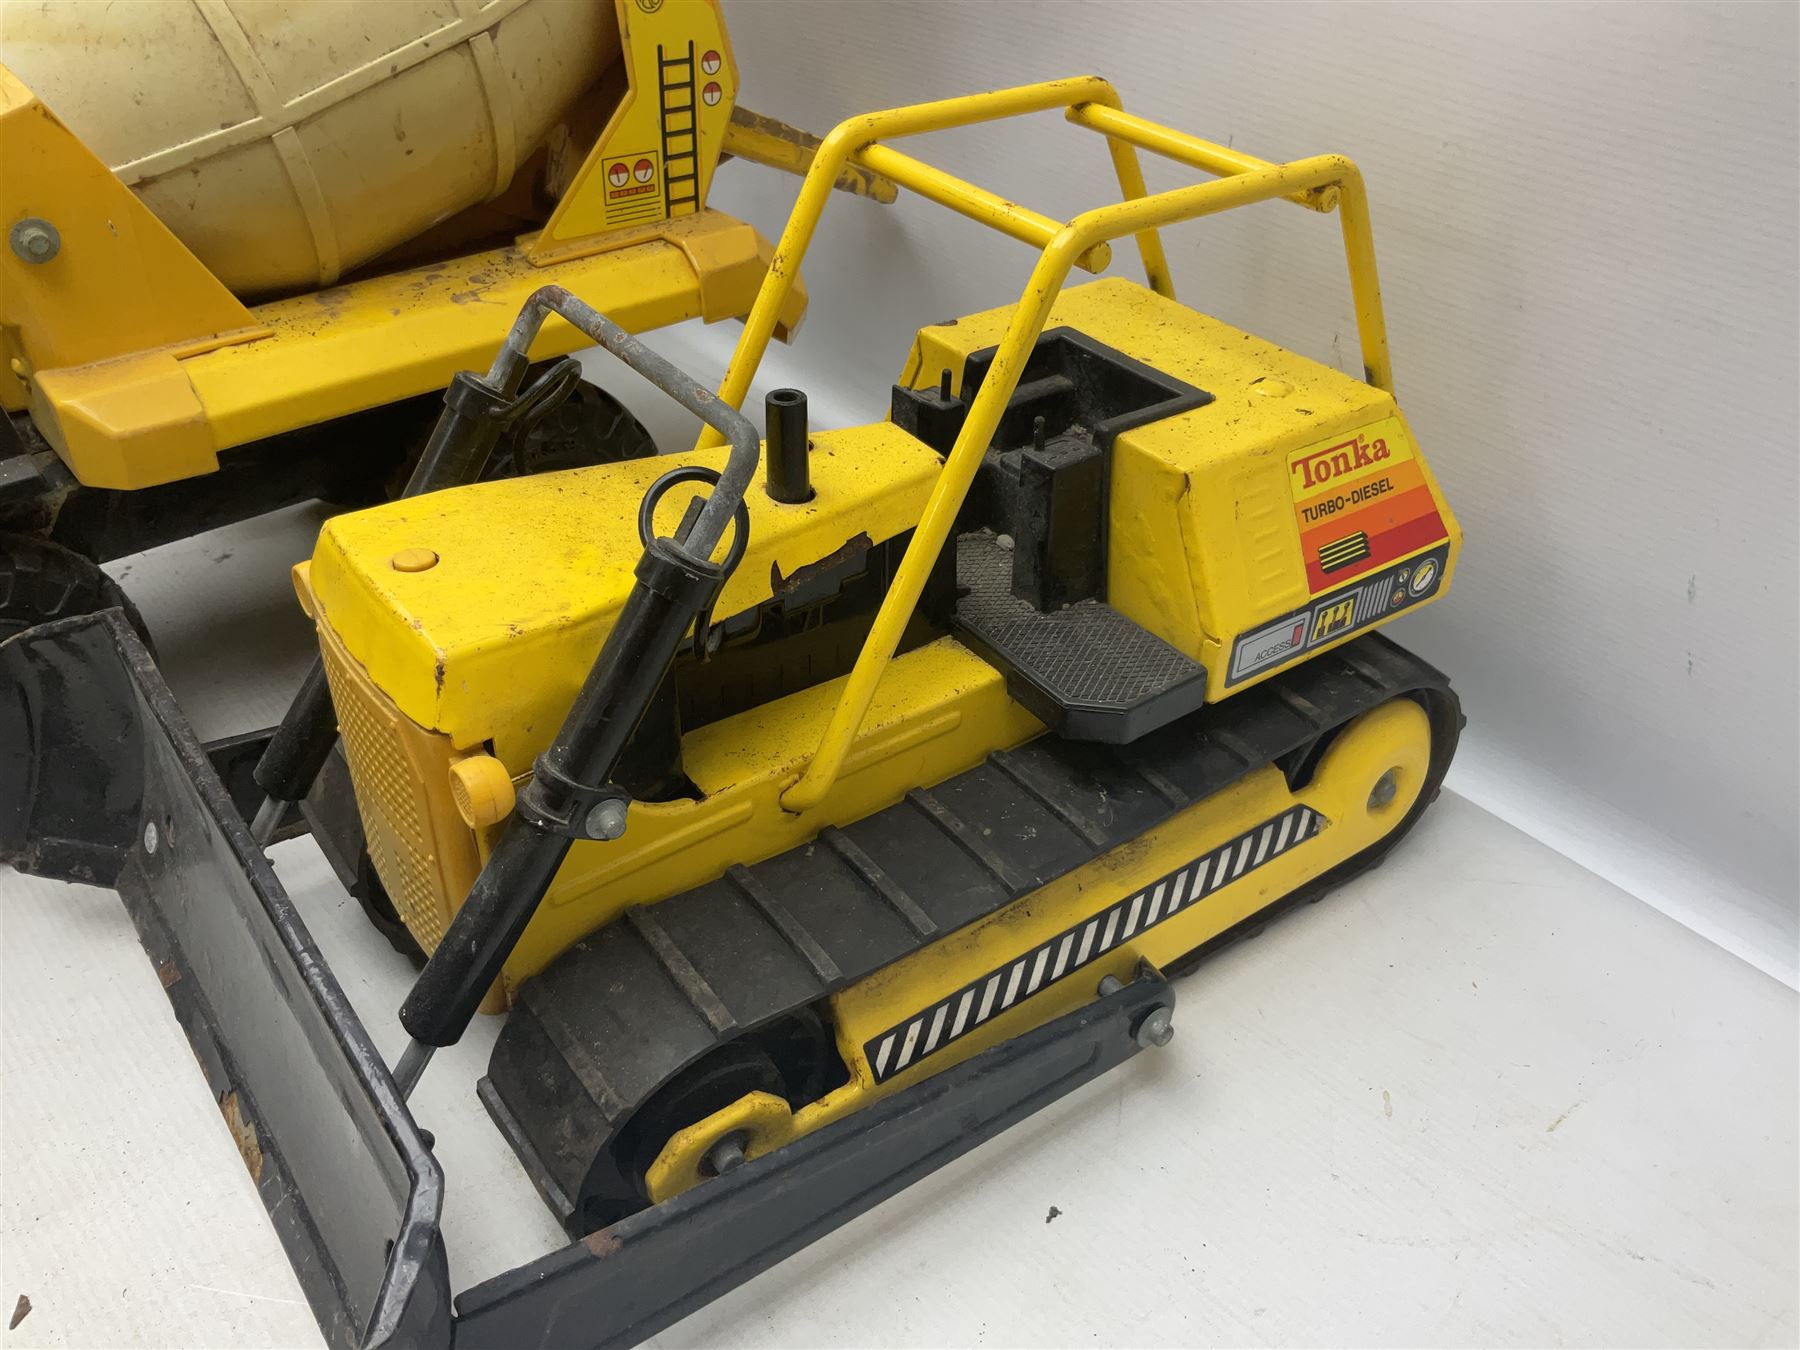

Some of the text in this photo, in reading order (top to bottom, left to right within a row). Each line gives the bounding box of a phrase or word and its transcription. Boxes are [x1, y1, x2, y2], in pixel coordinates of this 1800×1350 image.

[1292, 437, 1390, 489] Tonka
[1302, 478, 1394, 523] TURBO-DIESEL
[1255, 639, 1291, 661] ACCESS
